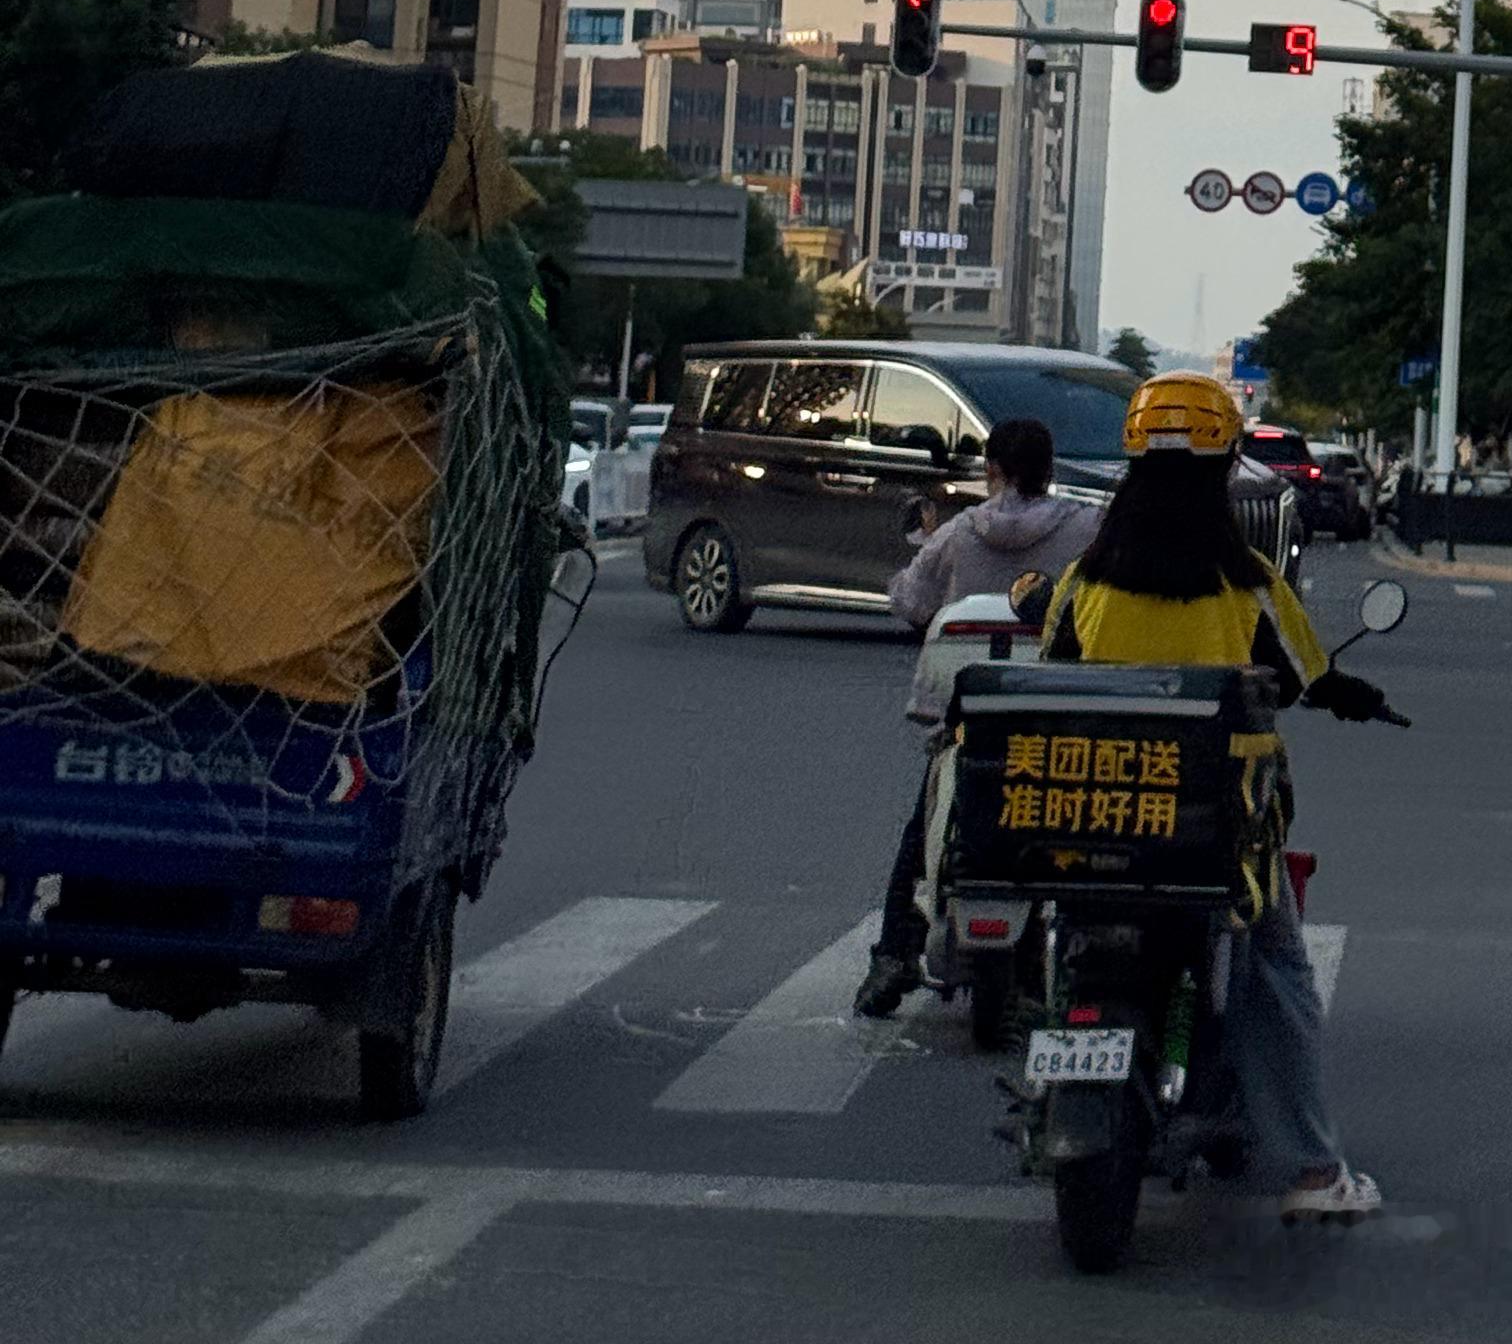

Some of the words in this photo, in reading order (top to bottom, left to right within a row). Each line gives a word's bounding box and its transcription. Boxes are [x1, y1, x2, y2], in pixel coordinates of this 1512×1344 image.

[1286, 27, 1314, 73] 9
[1199, 182, 1225, 200] 40
[1003, 733, 1180, 785] 美团配送
[998, 783, 1178, 838] 准时好用
